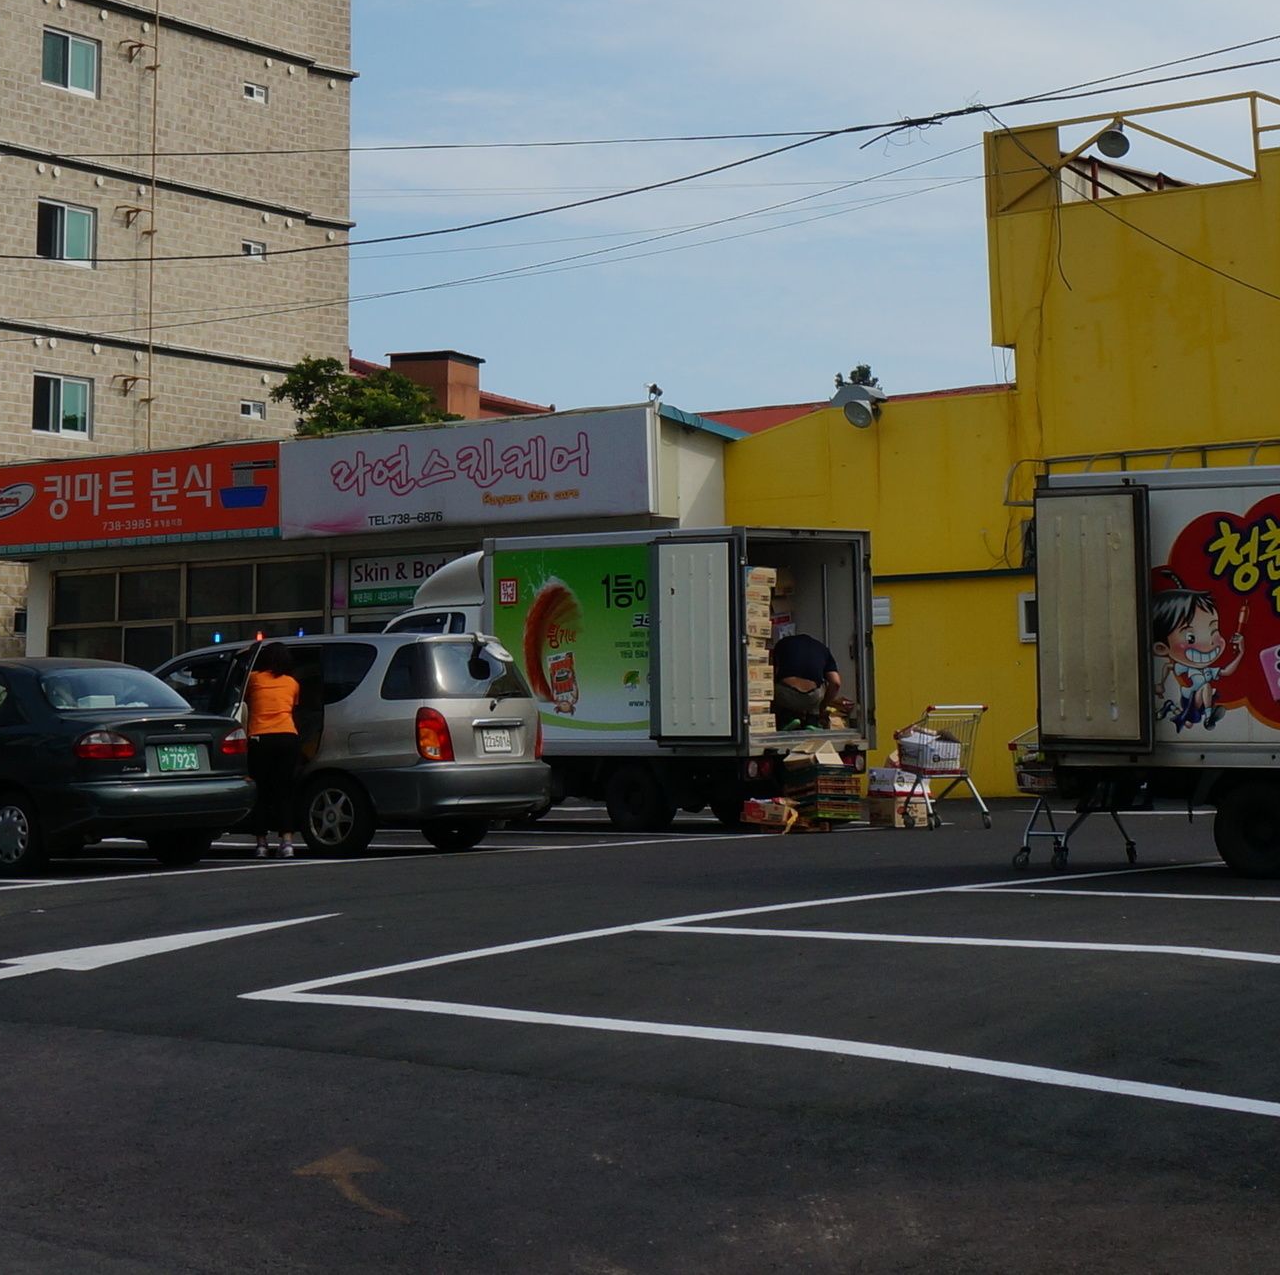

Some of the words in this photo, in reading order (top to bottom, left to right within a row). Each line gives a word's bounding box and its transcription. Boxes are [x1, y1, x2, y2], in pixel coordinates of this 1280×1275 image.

[43, 470, 136, 520] 킹마트
[149, 463, 213, 512] 분식
[367, 511, 443, 526] TEL:738-6876
[353, 564, 390, 583] Skin
[395, 562, 408, 580] &
